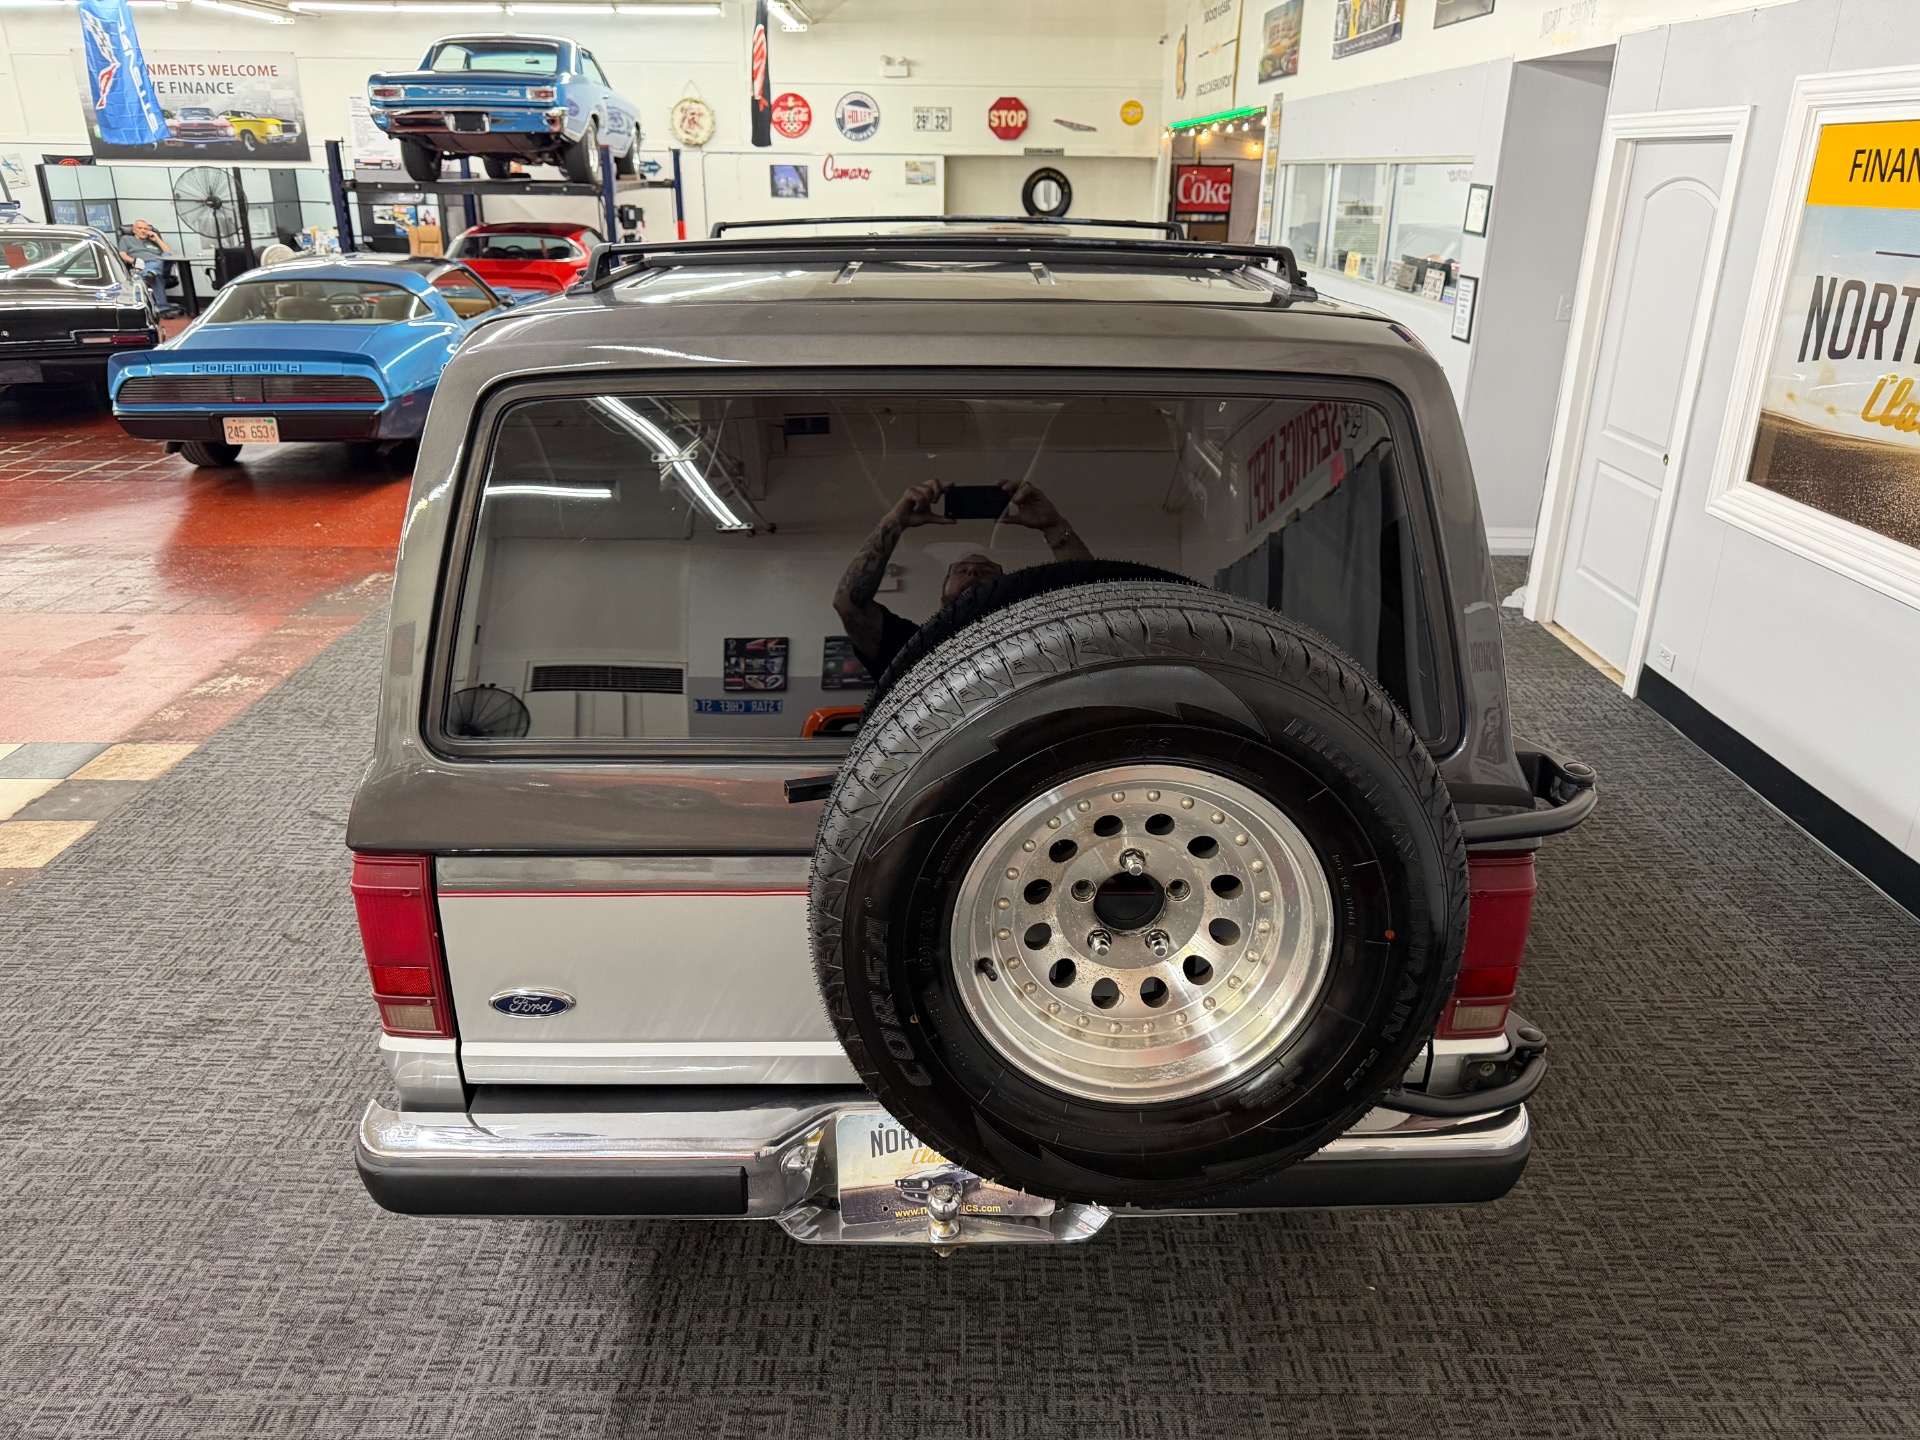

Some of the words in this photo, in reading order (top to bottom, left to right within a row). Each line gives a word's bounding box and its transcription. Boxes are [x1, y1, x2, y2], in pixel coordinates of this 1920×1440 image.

[208, 64, 279, 77] WELCOME
[169, 81, 235, 95] FINANCE
[989, 109, 1027, 128] STOP
[823, 153, 872, 181] Camaro
[1177, 172, 1231, 204] Coke
[1797, 275, 1920, 364] NORT
[192, 362, 302, 374] FORMULA
[226, 425, 246, 440] 245
[250, 425, 269, 439] 653
[508, 996, 553, 1014] Ford
